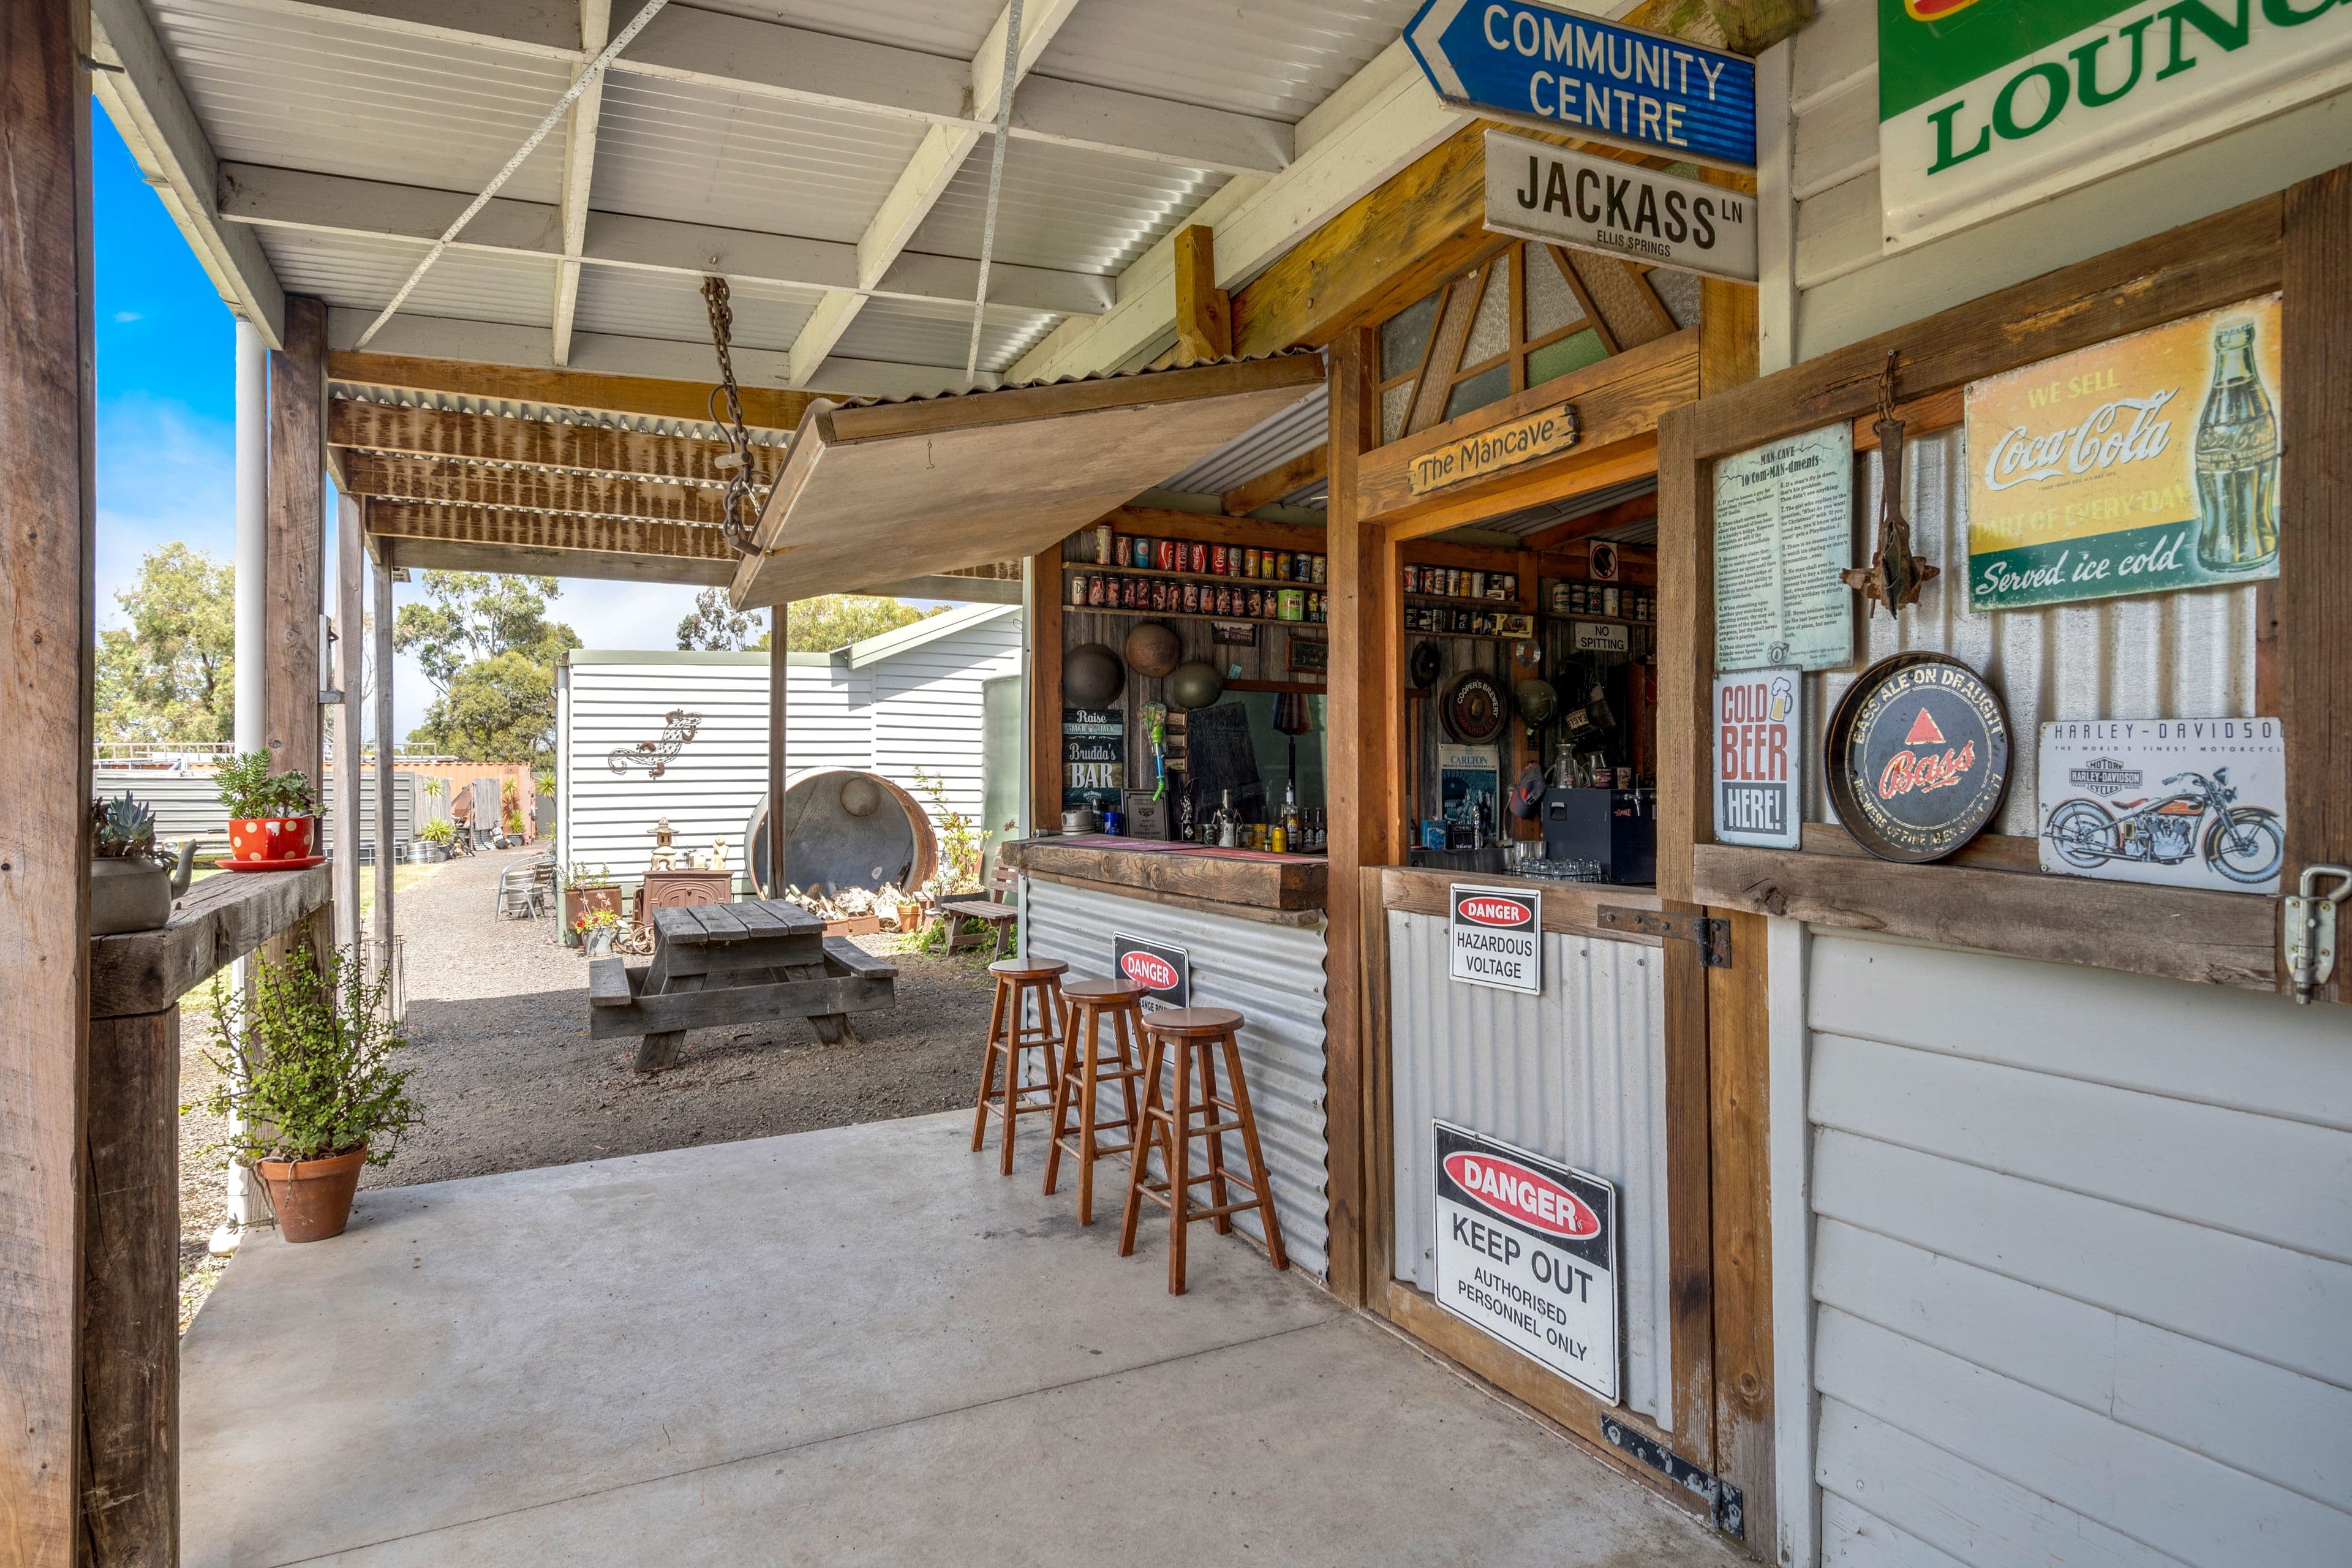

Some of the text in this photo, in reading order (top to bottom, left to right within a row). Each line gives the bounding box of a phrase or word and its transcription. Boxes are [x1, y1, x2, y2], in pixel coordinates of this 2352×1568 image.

[1484, 4, 1724, 100] COMMUNITY
[1927, 0, 2352, 176] LOUN
[1531, 70, 1687, 146] CENTRE
[1517, 156, 1742, 250] JACKASS LN
[1597, 230, 1670, 257] ELLIS SPRINGS
[2028, 368, 2119, 409] WE SELL
[1985, 386, 2180, 491] Coca-Cola
[1418, 453, 1453, 486] The
[1760, 446, 1795, 466] MAN CAVE
[1741, 475, 1749, 487] 10
[1801, 480, 1822, 491] problem.
[1815, 496, 1831, 505] replies
[1977, 483, 2187, 541] PART OF EVERY DAY
[1975, 532, 2184, 595] Served ice cold
[1580, 637, 1624, 650] SPITTING
[1595, 626, 1609, 636] NO
[1457, 680, 1499, 718] COOPER'S BREWERY
[1722, 684, 1767, 723] COLD
[1852, 668, 2004, 745] BASS ALE ON DRAUGHT
[1077, 710, 1107, 723] Raise
[2055, 722, 2283, 739] HARLEY-DAVIDSO
[1069, 742, 1117, 761] Brudda's
[1450, 755, 1488, 764] CARLTON
[1721, 724, 1787, 781] BEER
[2090, 759, 2119, 769] MOTOR
[1071, 763, 1114, 788] BAR
[1879, 740, 1975, 800] Bass
[2072, 771, 2139, 783] HARLEY-DAVIDSON
[2090, 785, 2119, 795] CYCLES
[1727, 788, 1781, 830] HERE!
[1468, 902, 1520, 921] DANGER
[1457, 932, 1532, 957] HAZARDOUS
[1128, 956, 1170, 986] DANGER
[1466, 955, 1521, 979] VOLTAGE
[1142, 999, 1154, 1012] ANGE
[1464, 1158, 1577, 1232] DANGER
[1452, 1212, 1593, 1303] KEEP OUT
[1474, 1266, 1567, 1325] AUTHORISED
[1458, 1279, 1588, 1362] PERSONNEL ONLY
